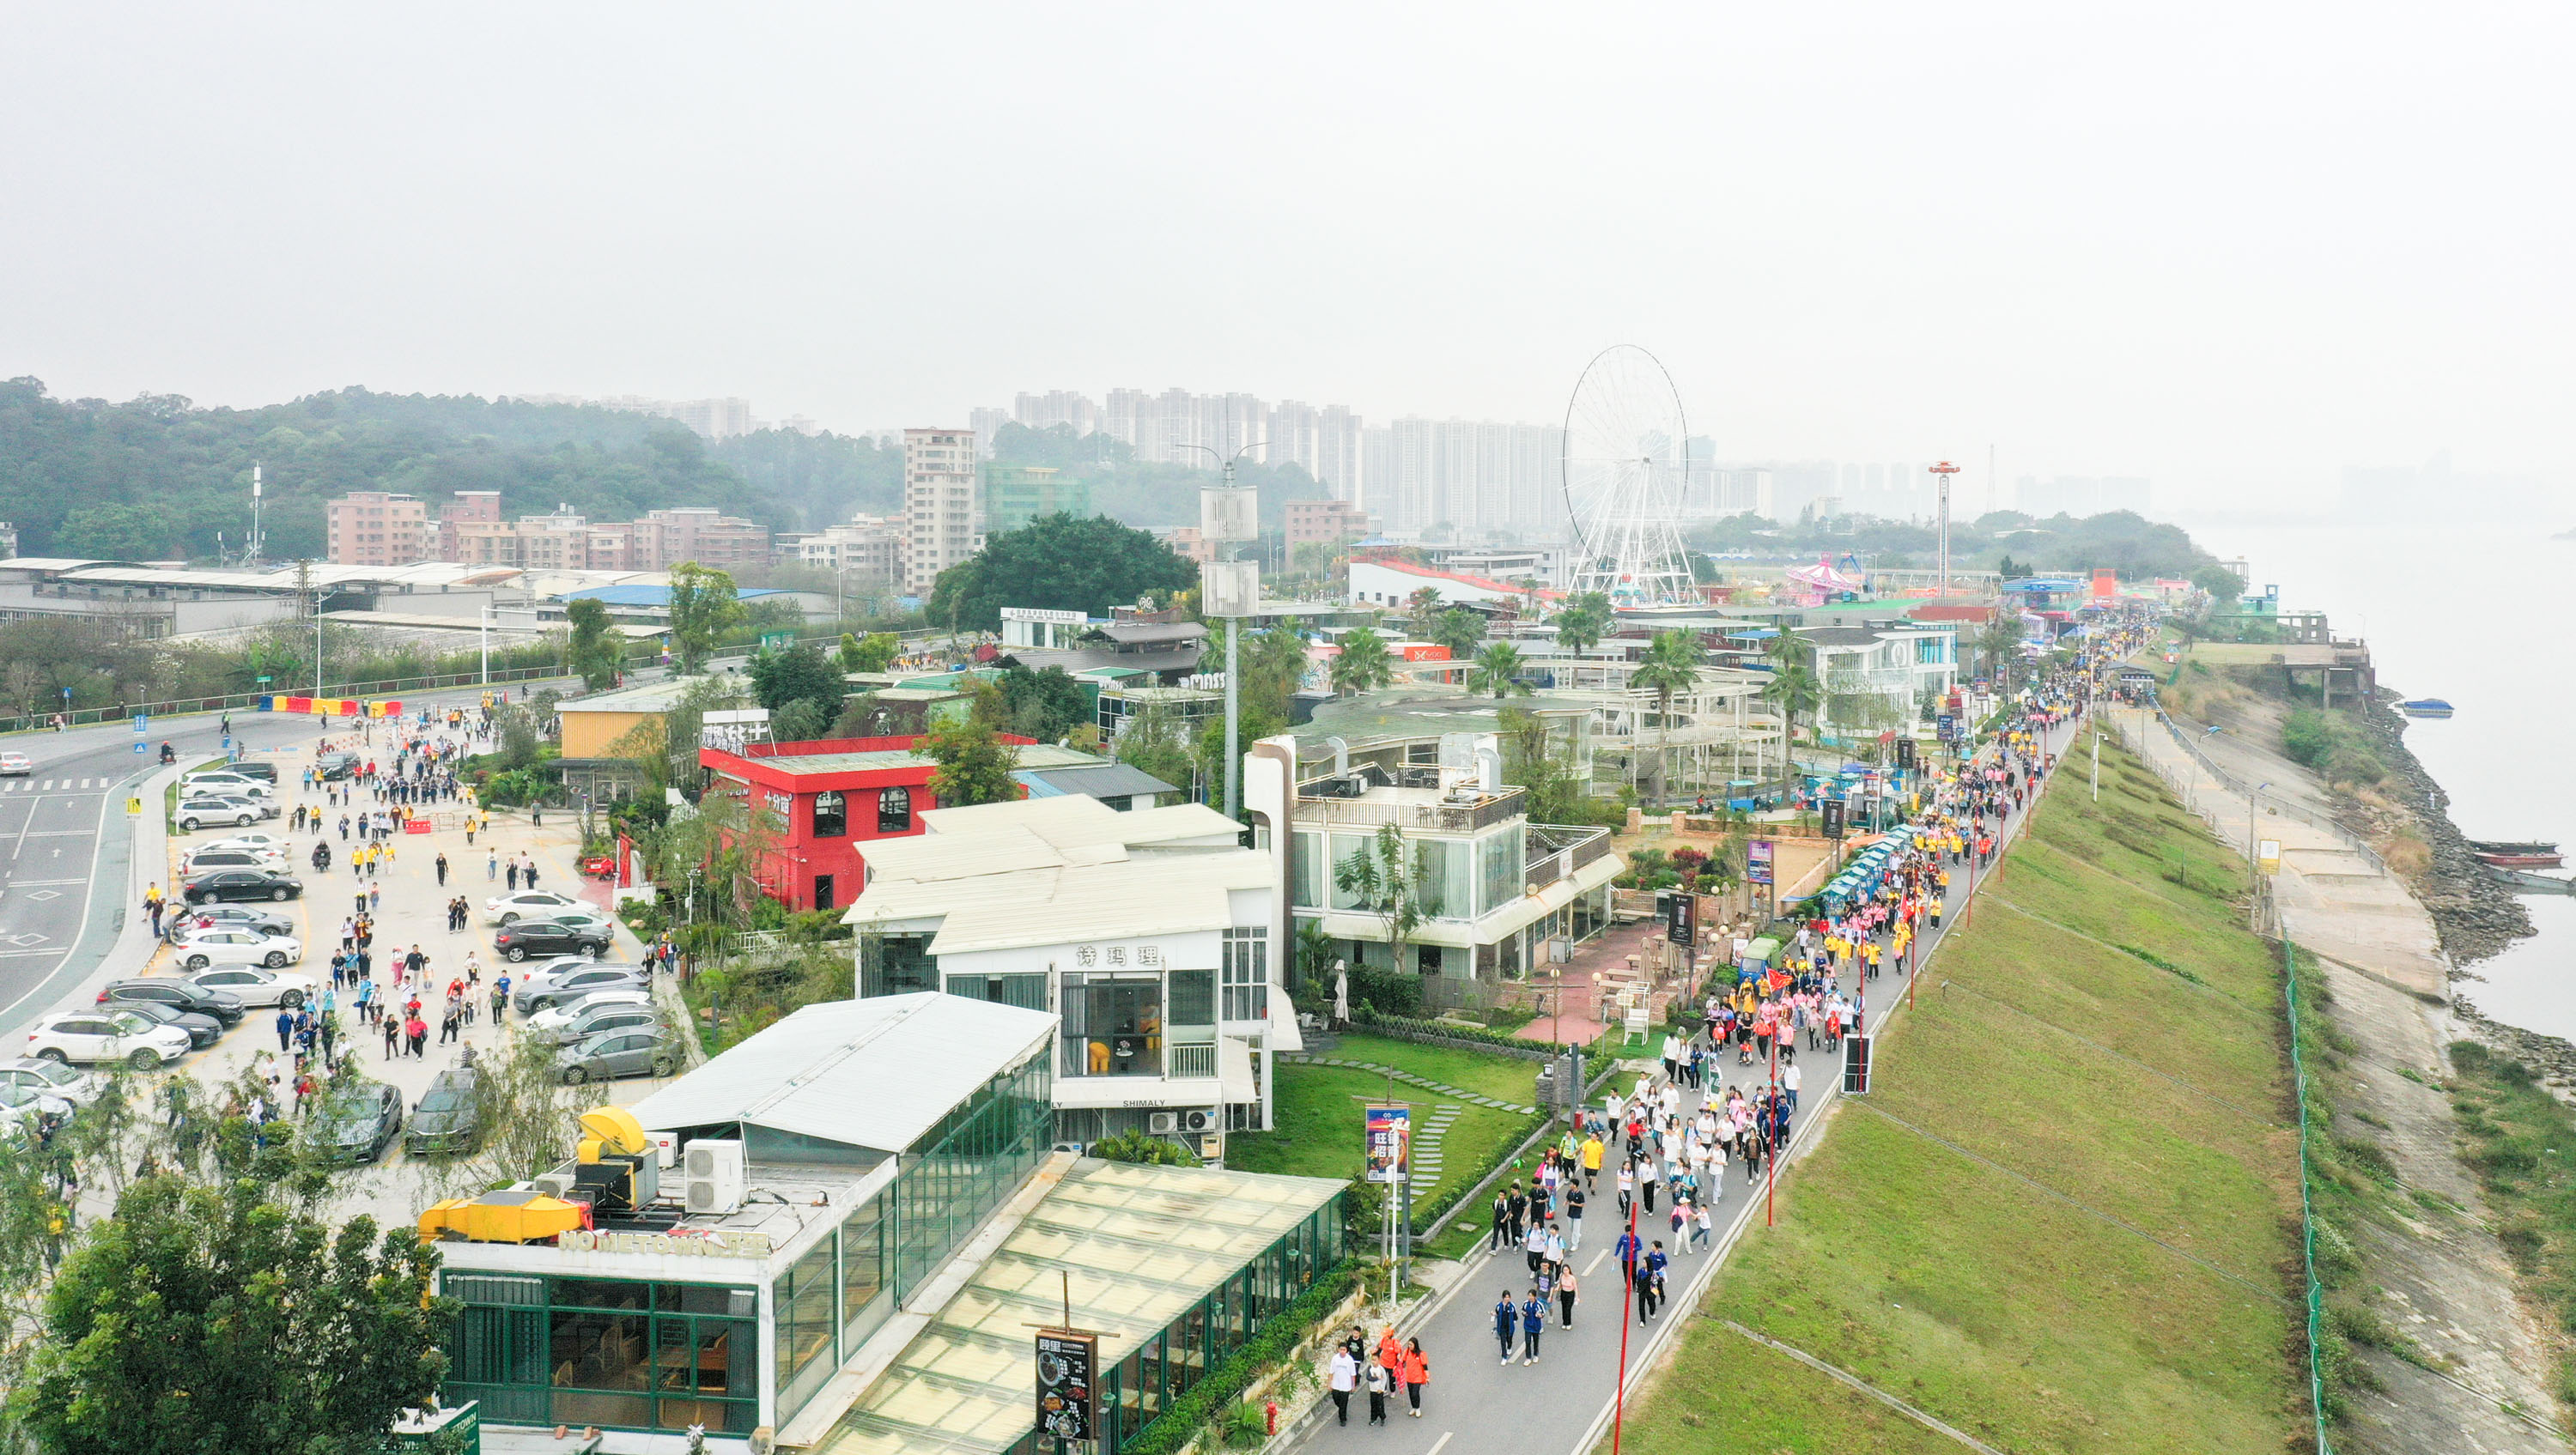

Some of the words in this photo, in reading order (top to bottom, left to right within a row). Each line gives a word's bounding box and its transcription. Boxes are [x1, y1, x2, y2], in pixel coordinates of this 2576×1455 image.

[1189, 673, 1226, 690] MASS
[1077, 945, 1158, 967] 诗玛理
[558, 1230, 708, 1257] HOMETOWN
[1039, 1338, 1061, 1353] 顾里
